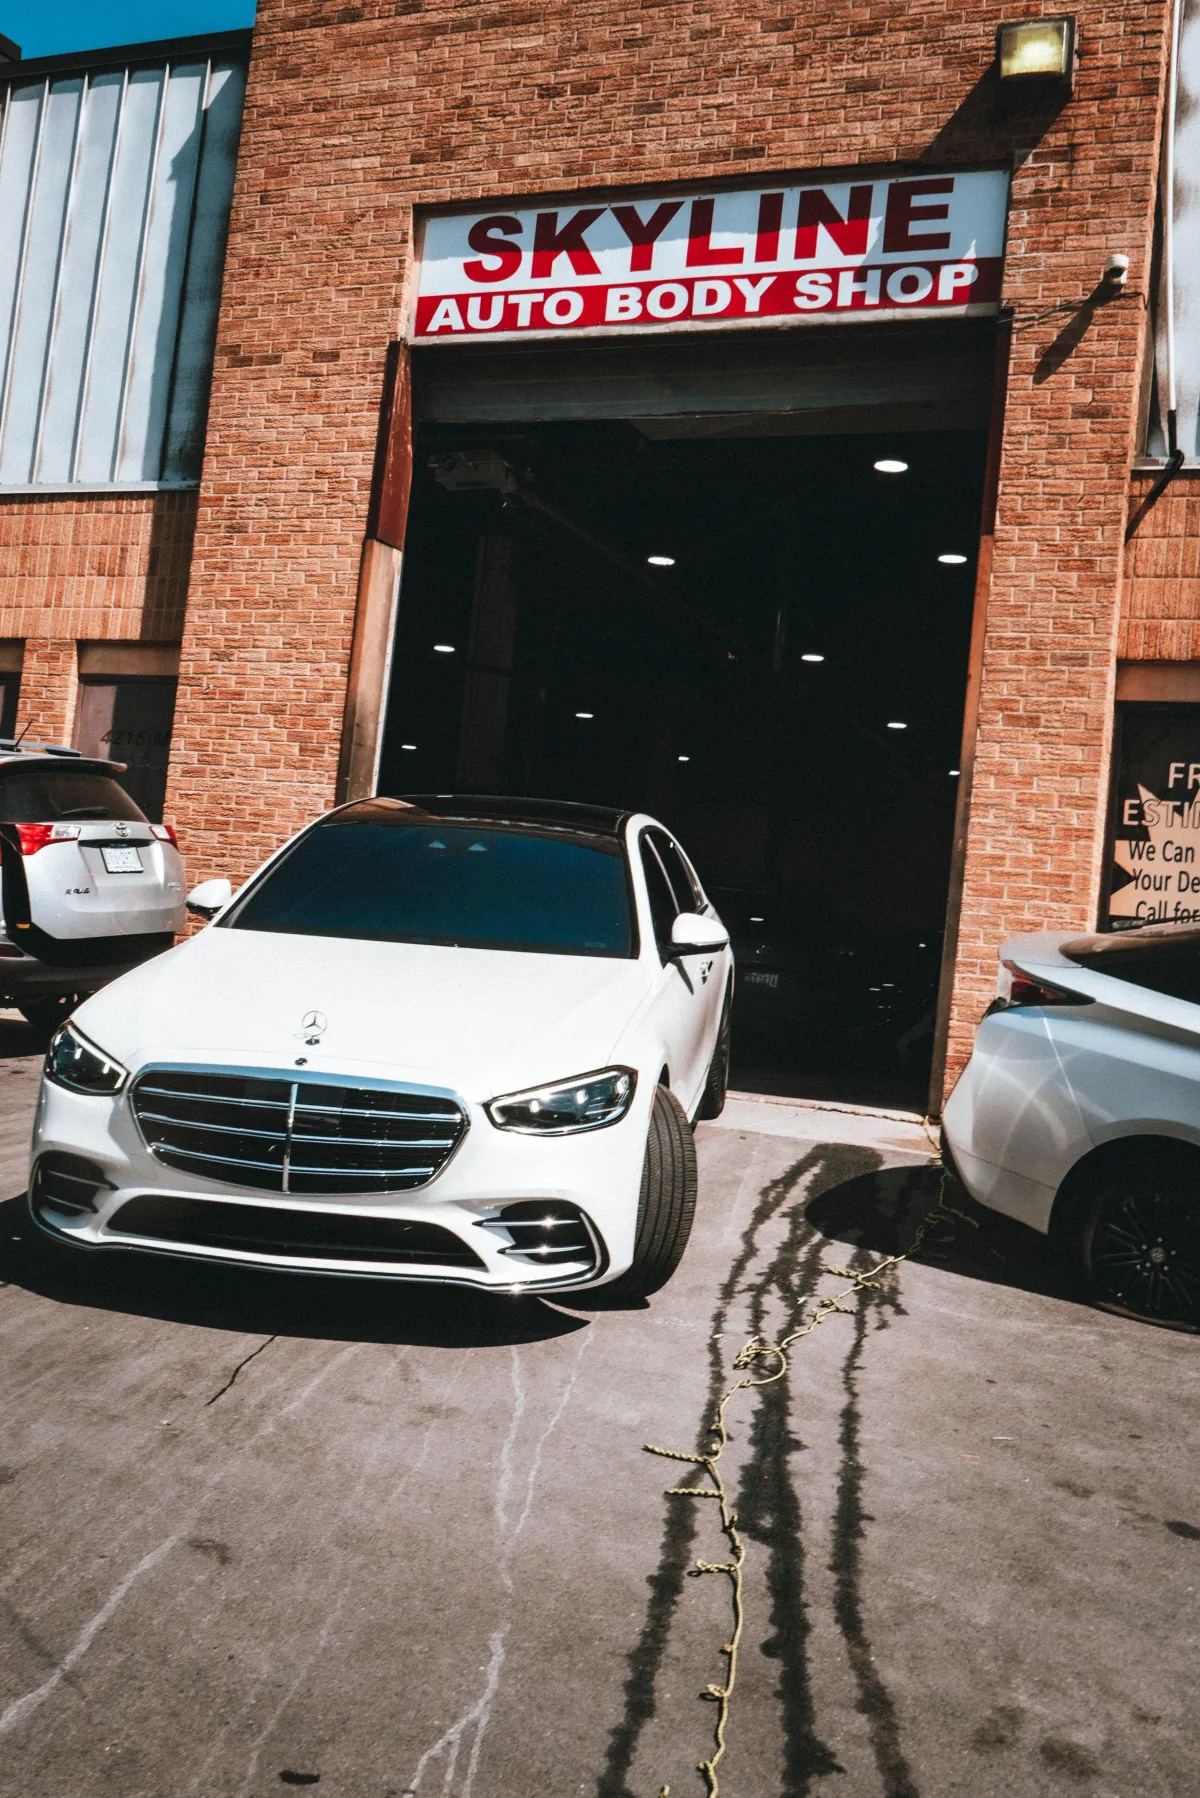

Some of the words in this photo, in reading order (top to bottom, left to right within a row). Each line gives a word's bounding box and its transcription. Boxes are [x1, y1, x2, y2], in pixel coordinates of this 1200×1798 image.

[463, 177, 954, 283] SKYLINE
[426, 290, 585, 332] AUTO
[604, 275, 778, 322] BODY
[793, 262, 979, 309] SHOP
[101, 730, 148, 746] 4215
[1129, 840, 1155, 861] We
[1162, 840, 1195, 863] Can
[1133, 868, 1172, 892] Your
[1178, 871, 1200, 893] De
[1136, 900, 1167, 921] Call
